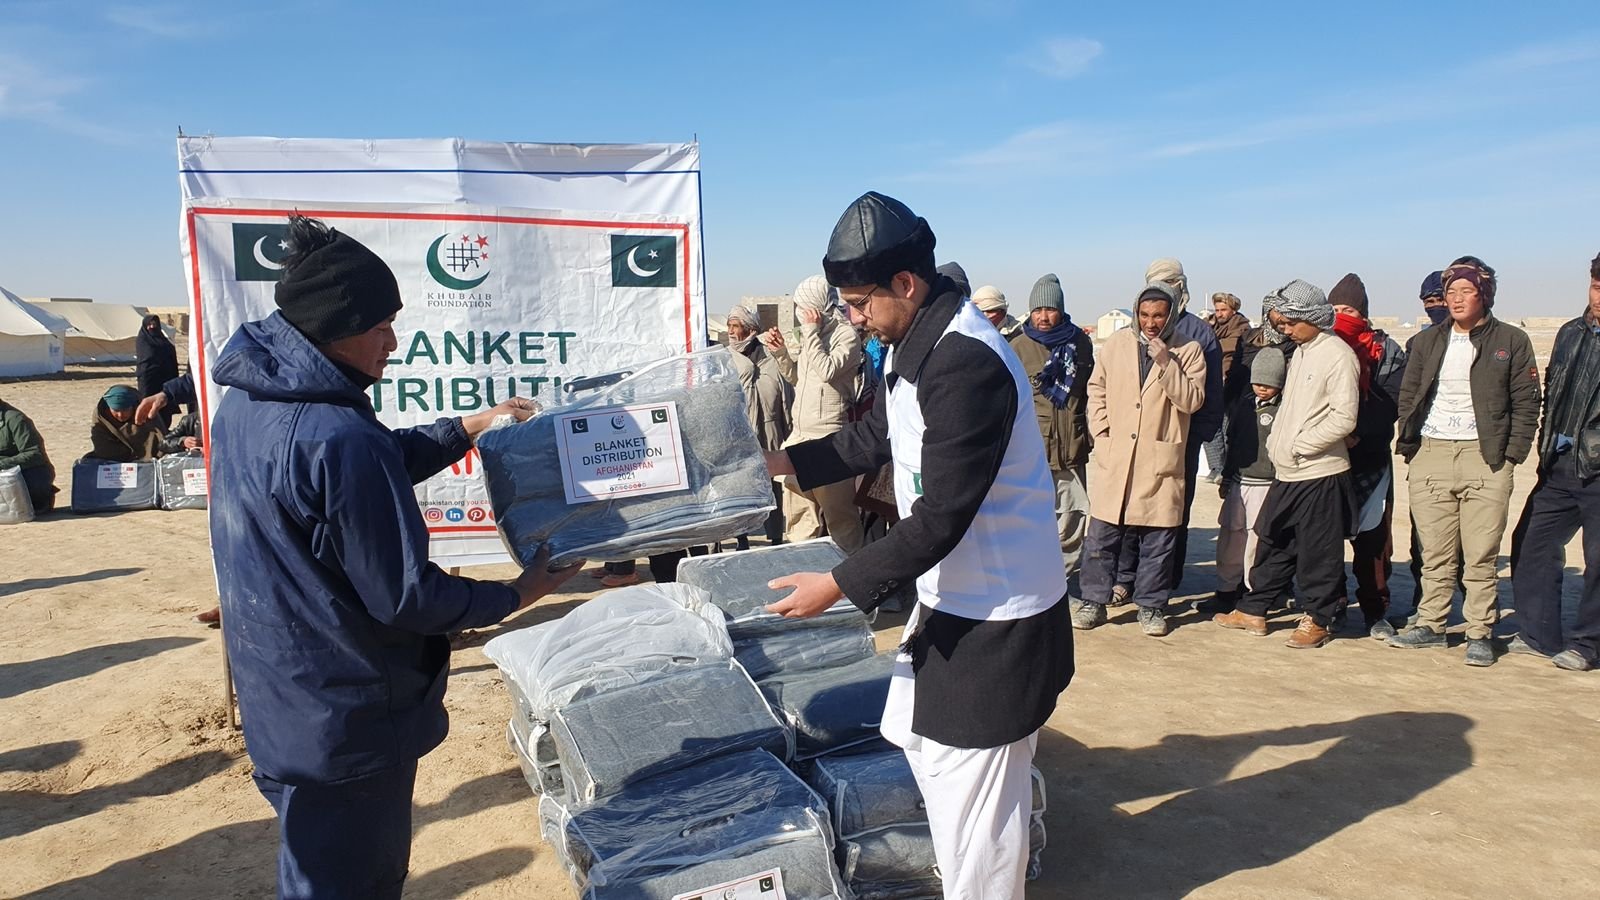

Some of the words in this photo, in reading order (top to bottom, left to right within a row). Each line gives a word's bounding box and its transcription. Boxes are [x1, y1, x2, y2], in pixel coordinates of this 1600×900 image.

[427, 292, 492, 300] KHUBAIB
[427, 300, 492, 308] FOUNDATION
[386, 330, 577, 365] ANKET
[594, 436, 647, 453] BLANKET
[582, 446, 662, 466] DISTRIBUTION
[596, 461, 654, 476] AFGHANISTAN
[616, 471, 636, 481] 2021
